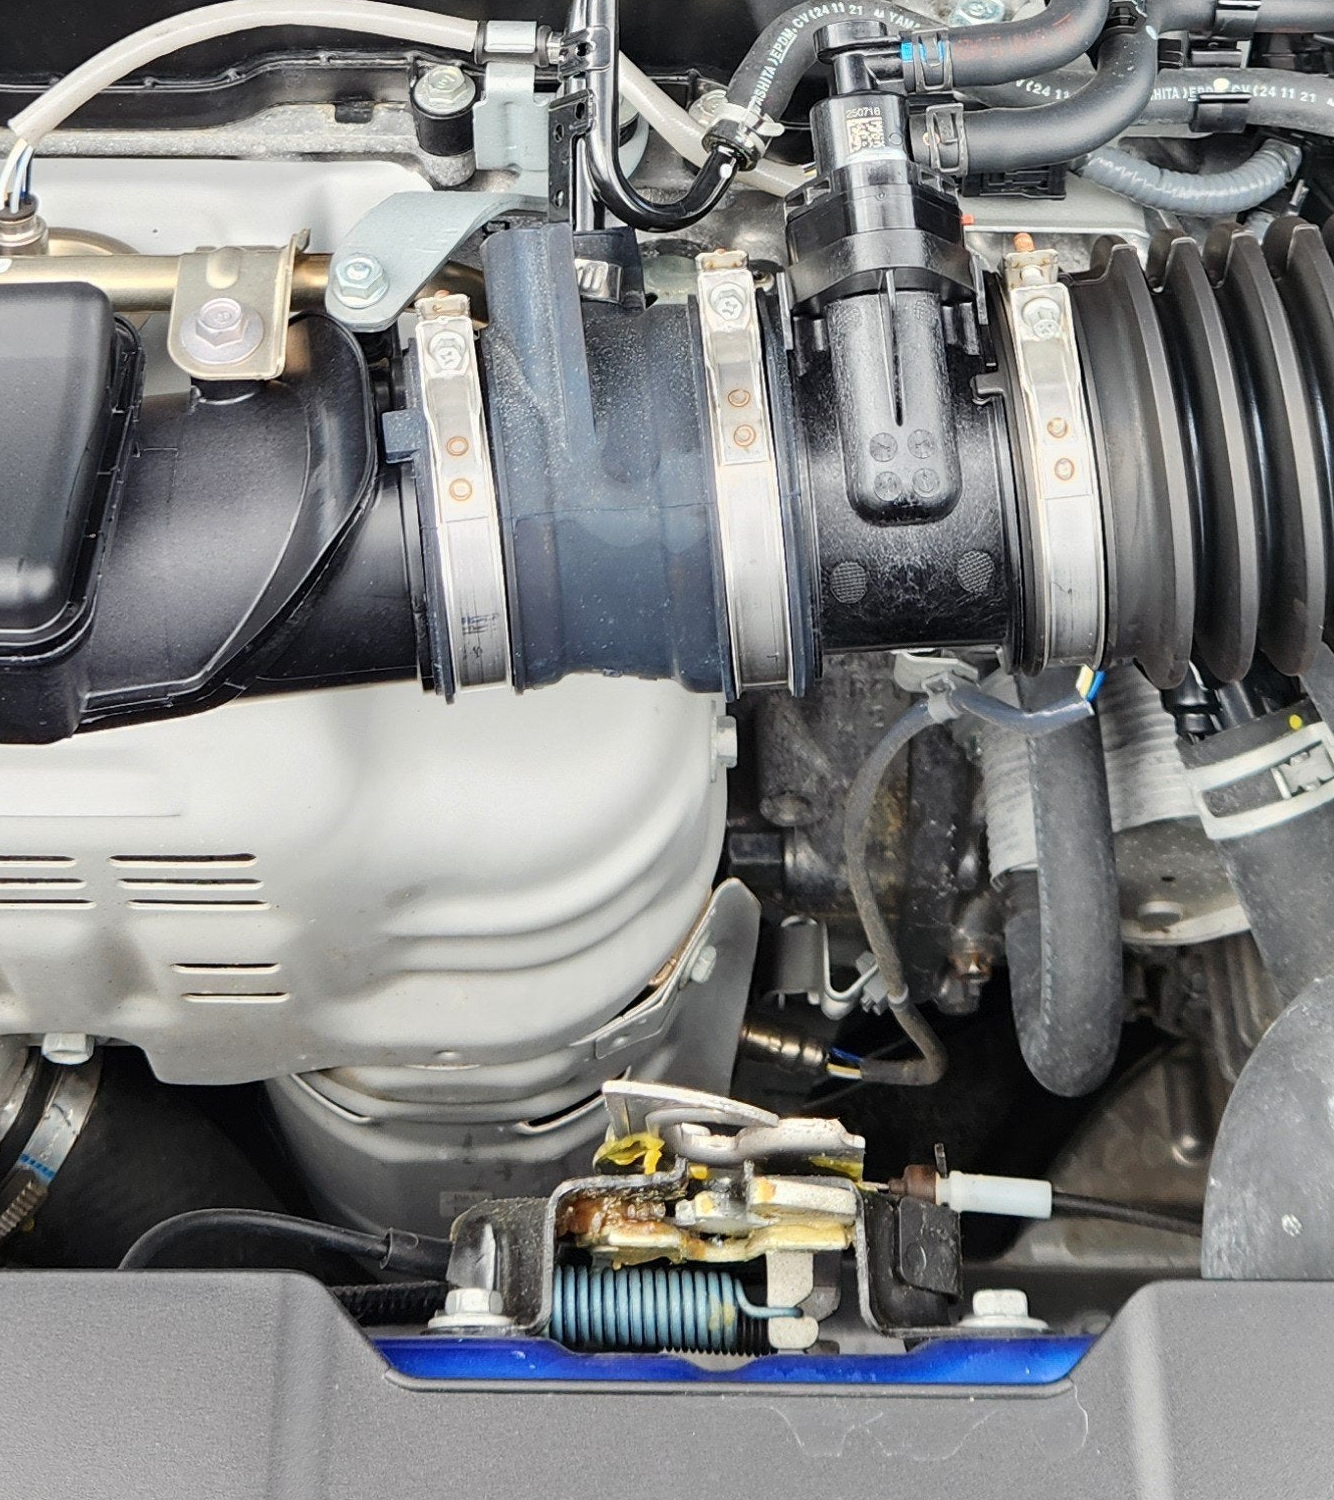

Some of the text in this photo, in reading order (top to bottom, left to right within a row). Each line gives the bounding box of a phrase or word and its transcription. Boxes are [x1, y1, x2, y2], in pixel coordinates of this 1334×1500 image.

[831, 2, 846, 14] 11
[849, 4, 863, 16] 21
[888, 11, 921, 29] YAM
[1300, 91, 1316, 103] 21
